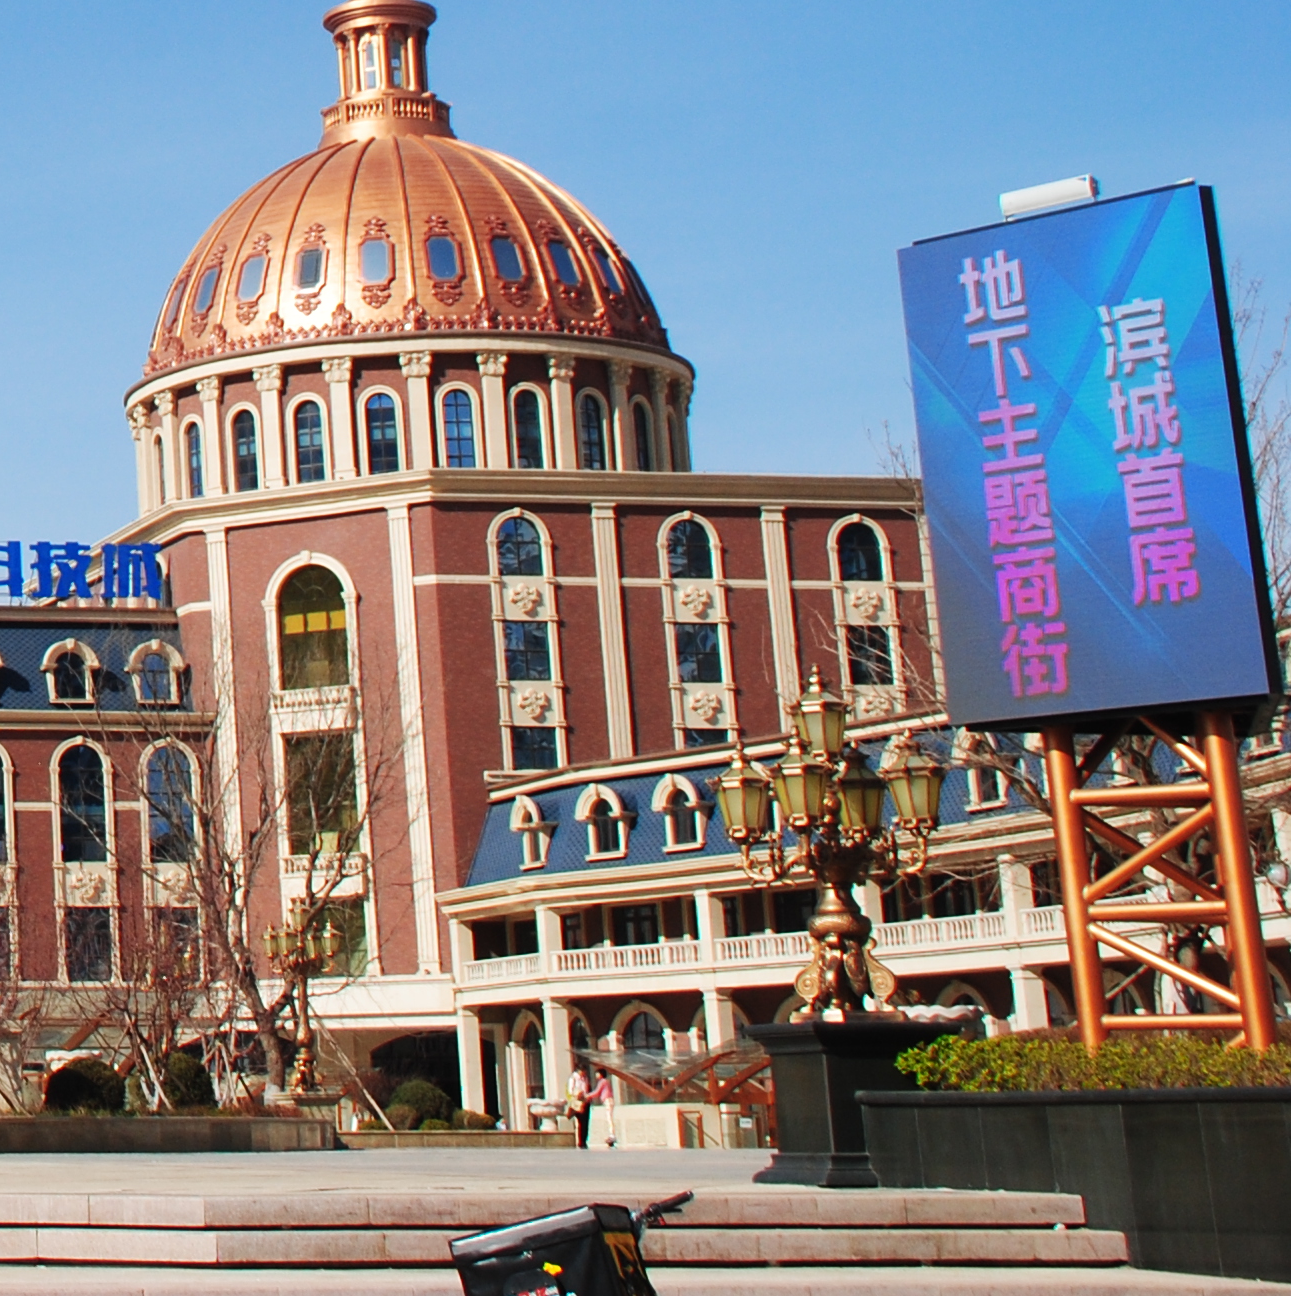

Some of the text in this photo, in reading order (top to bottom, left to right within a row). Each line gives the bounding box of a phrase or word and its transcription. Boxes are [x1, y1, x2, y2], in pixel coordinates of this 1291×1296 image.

[959, 249, 1069, 698] 地下主题商街
[1098, 297, 1201, 606] 滨城首席
